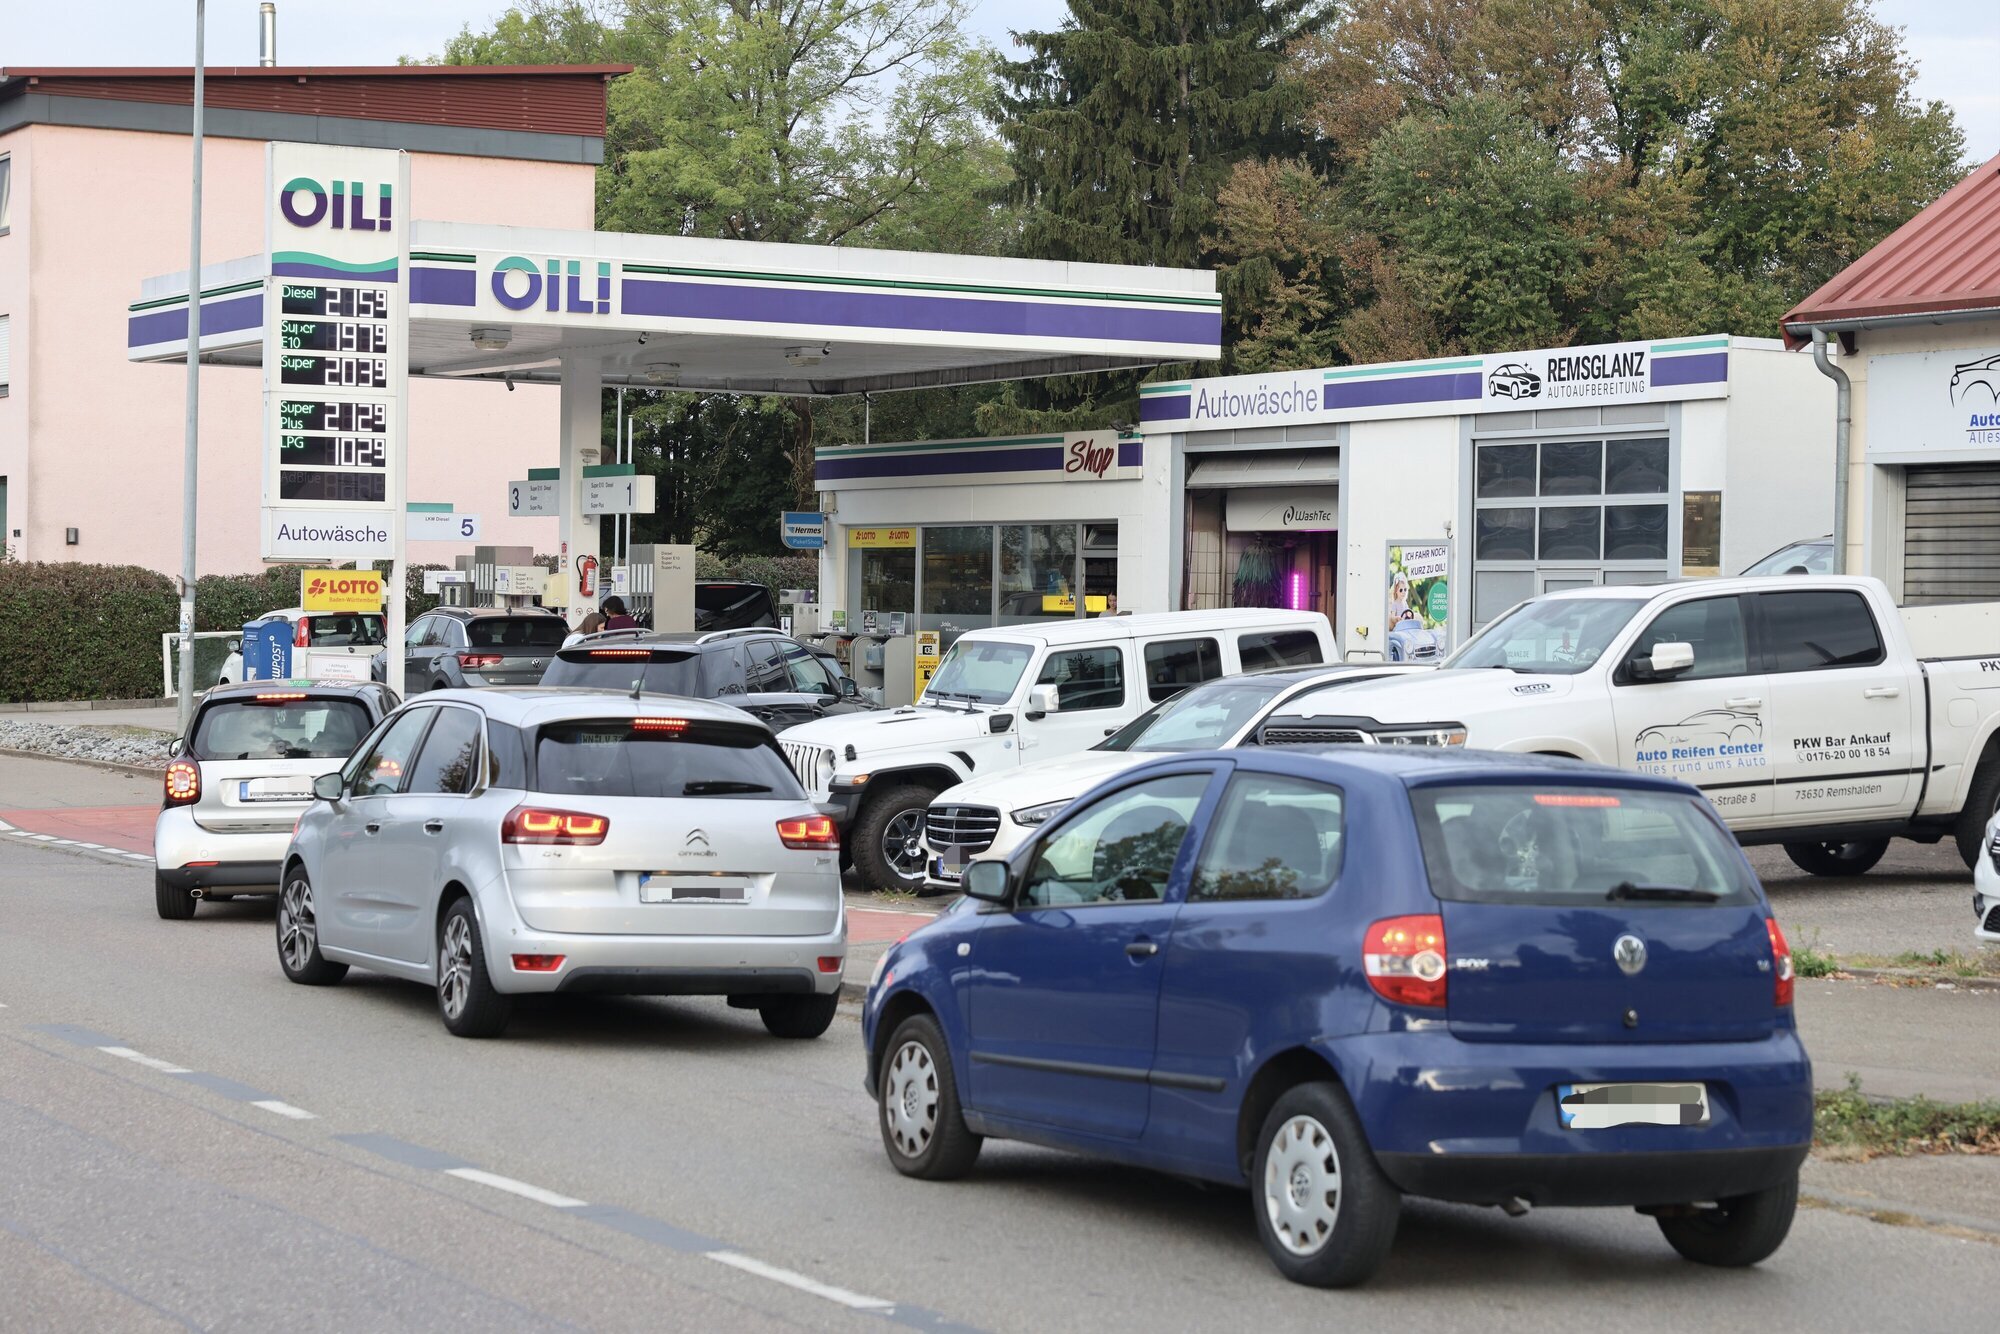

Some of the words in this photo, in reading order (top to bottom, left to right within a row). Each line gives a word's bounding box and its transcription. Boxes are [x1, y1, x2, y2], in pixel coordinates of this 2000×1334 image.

[281, 177, 392, 232] OIL!
[282, 285, 316, 299] Diesel
[492, 256, 610, 315] OIL!
[282, 336, 301, 349] E10
[281, 355, 315, 371] Super
[1547, 351, 1645, 383] REMSGLANZ
[1547, 380, 1645, 399] AUTOAUFBEREITUNG
[1195, 380, 1318, 420] Autowäsche
[280, 401, 315, 416] Super
[280, 417, 304, 429] Plus
[280, 436, 304, 449] LPG
[1065, 438, 1115, 479] Shop
[512, 487, 519, 510] 3
[627, 482, 632, 506] 1
[1295, 510, 1331, 521] WashTec
[277, 524, 387, 542] Autowäsche
[461, 518, 474, 537] 5
[794, 526, 822, 535] Hermes
[895, 530, 910, 540] LOTTO
[792, 538, 821, 546] PaketShop
[861, 531, 876, 541] LOTTO
[1405, 552, 1414, 561] ICH
[1415, 549, 1430, 560] FAHR
[1431, 547, 1446, 558] NOCH
[1411, 565, 1426, 576] KURZ
[1426, 564, 1434, 573] ZU
[1435, 563, 1446, 573] OIL!
[329, 579, 379, 594] LOTTO
[271, 641, 281, 679] WPOST
[1979, 660, 2000, 672] PK
[1793, 737, 1822, 749] PKW
[1825, 736, 1846, 747] Bar
[1850, 732, 1891, 745] Ankauf
[1636, 750, 1668, 762] Auto
[1672, 746, 1715, 759] Reifen
[1719, 742, 1764, 755] Center
[1806, 750, 1846, 762] 0176-20
[1849, 748, 1861, 759] 00
[1864, 747, 1876, 757] 18
[1879, 747, 1891, 756] 54
[1672, 761, 1701, 773] rund
[1707, 759, 1732, 770] ums
[1738, 756, 1766, 768] Auto
[1750, 793, 1757, 803] 8
[1795, 790, 1824, 800] 73630
[1826, 784, 1882, 798] Remshalden
